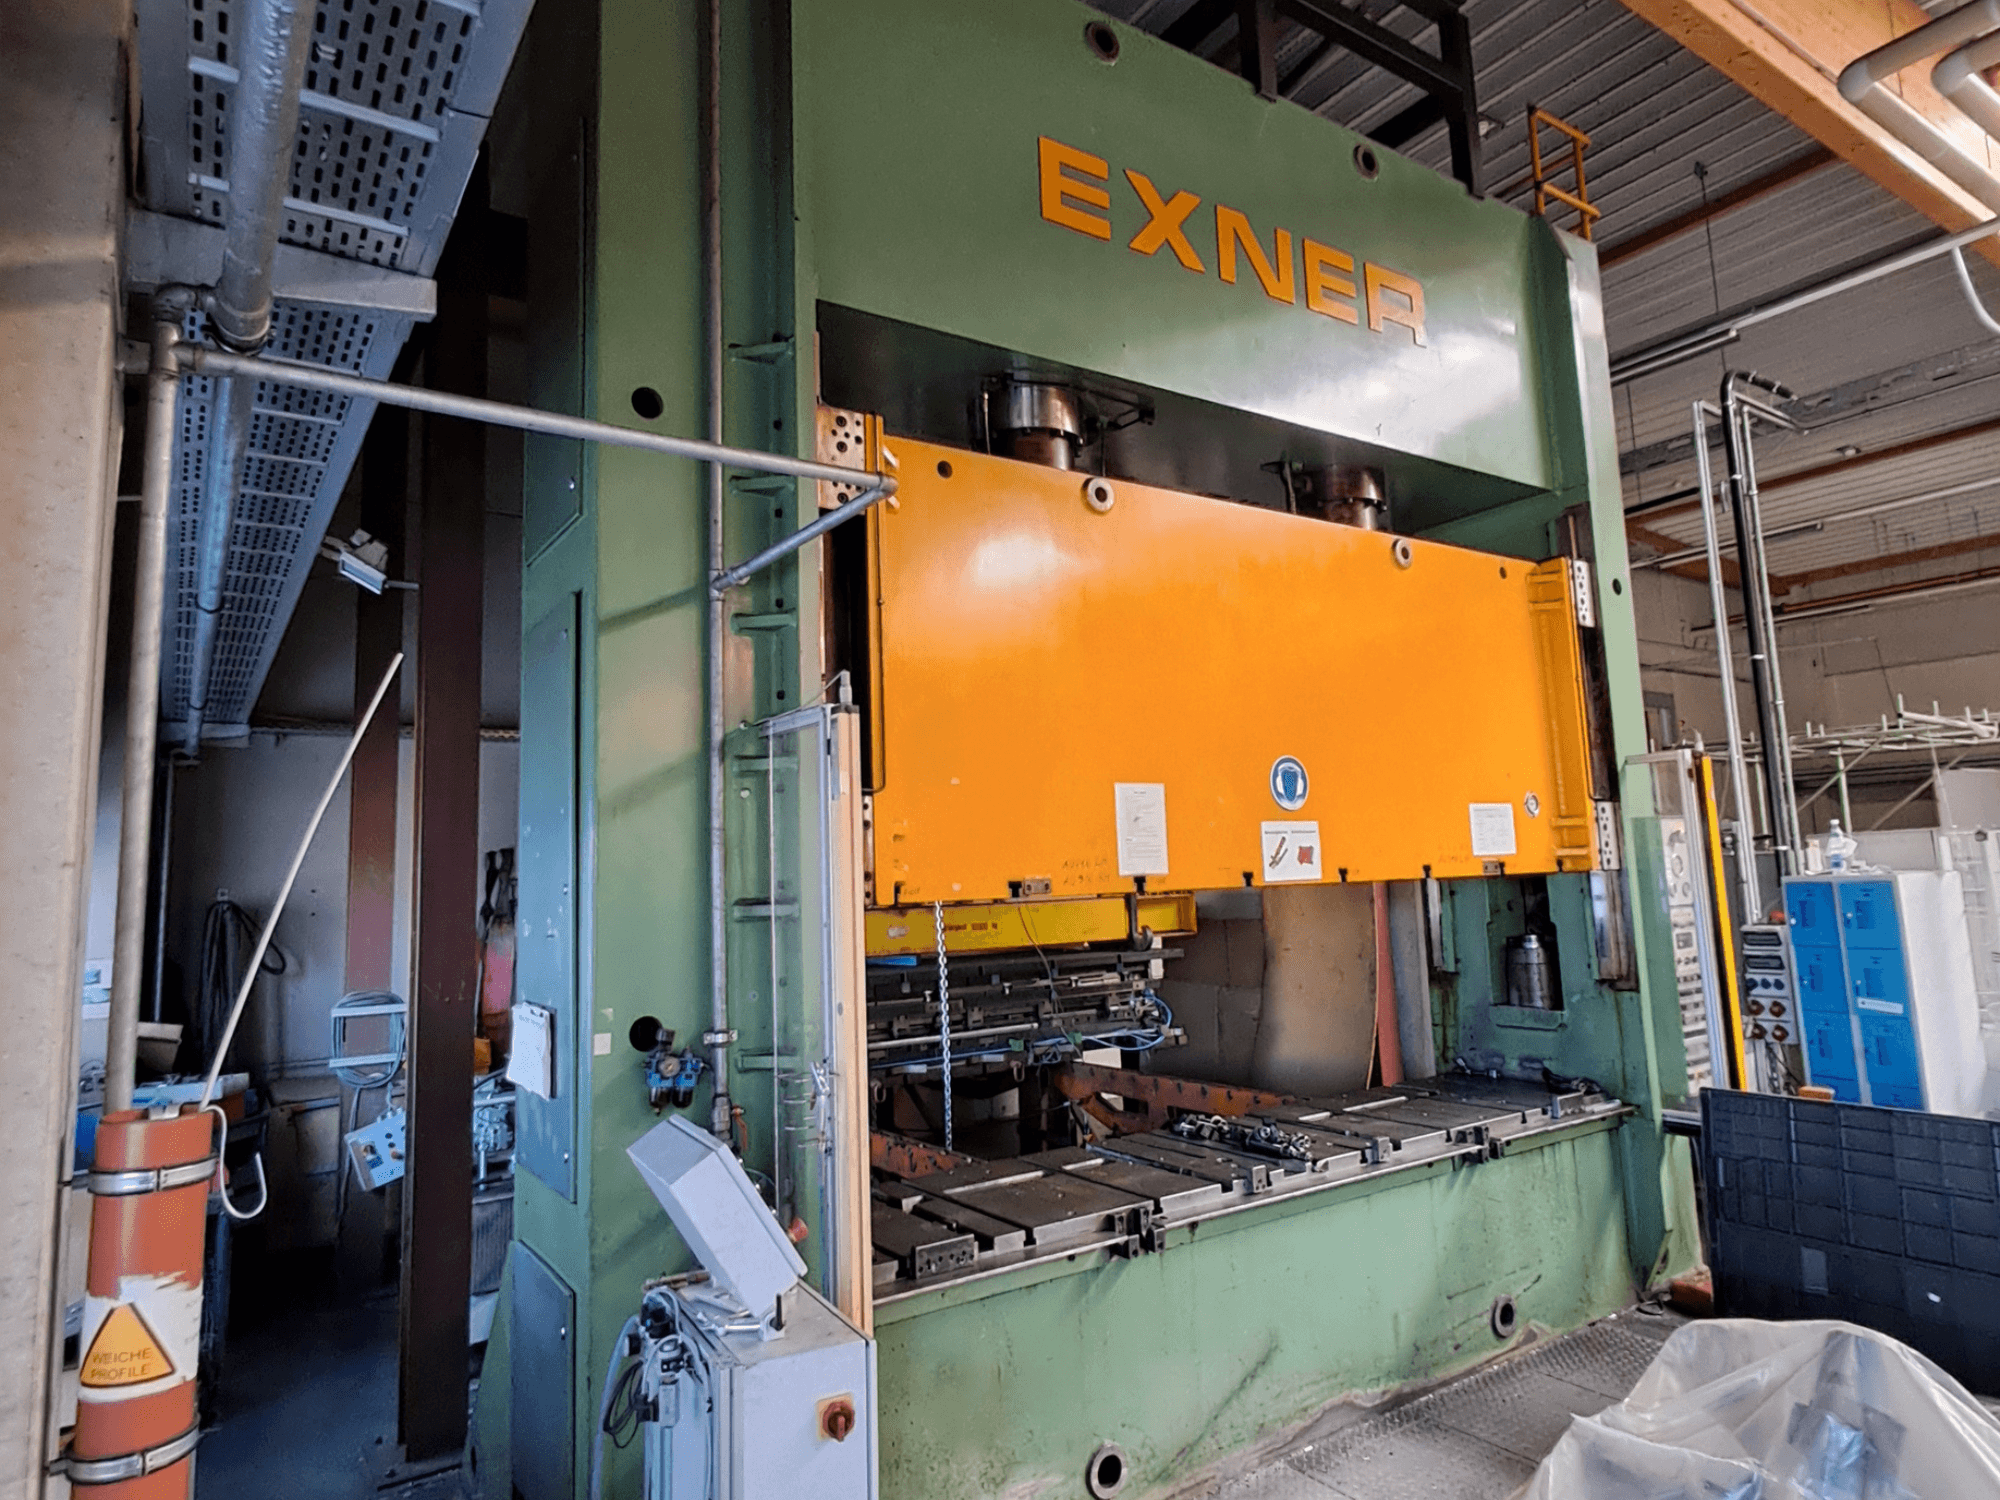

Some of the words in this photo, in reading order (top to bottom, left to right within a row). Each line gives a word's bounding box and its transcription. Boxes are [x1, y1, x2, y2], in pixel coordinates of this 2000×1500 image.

[1038, 135, 1427, 348] EXNER
[92, 1347, 152, 1364] WEICHE
[90, 1362, 151, 1380] PROFILE
